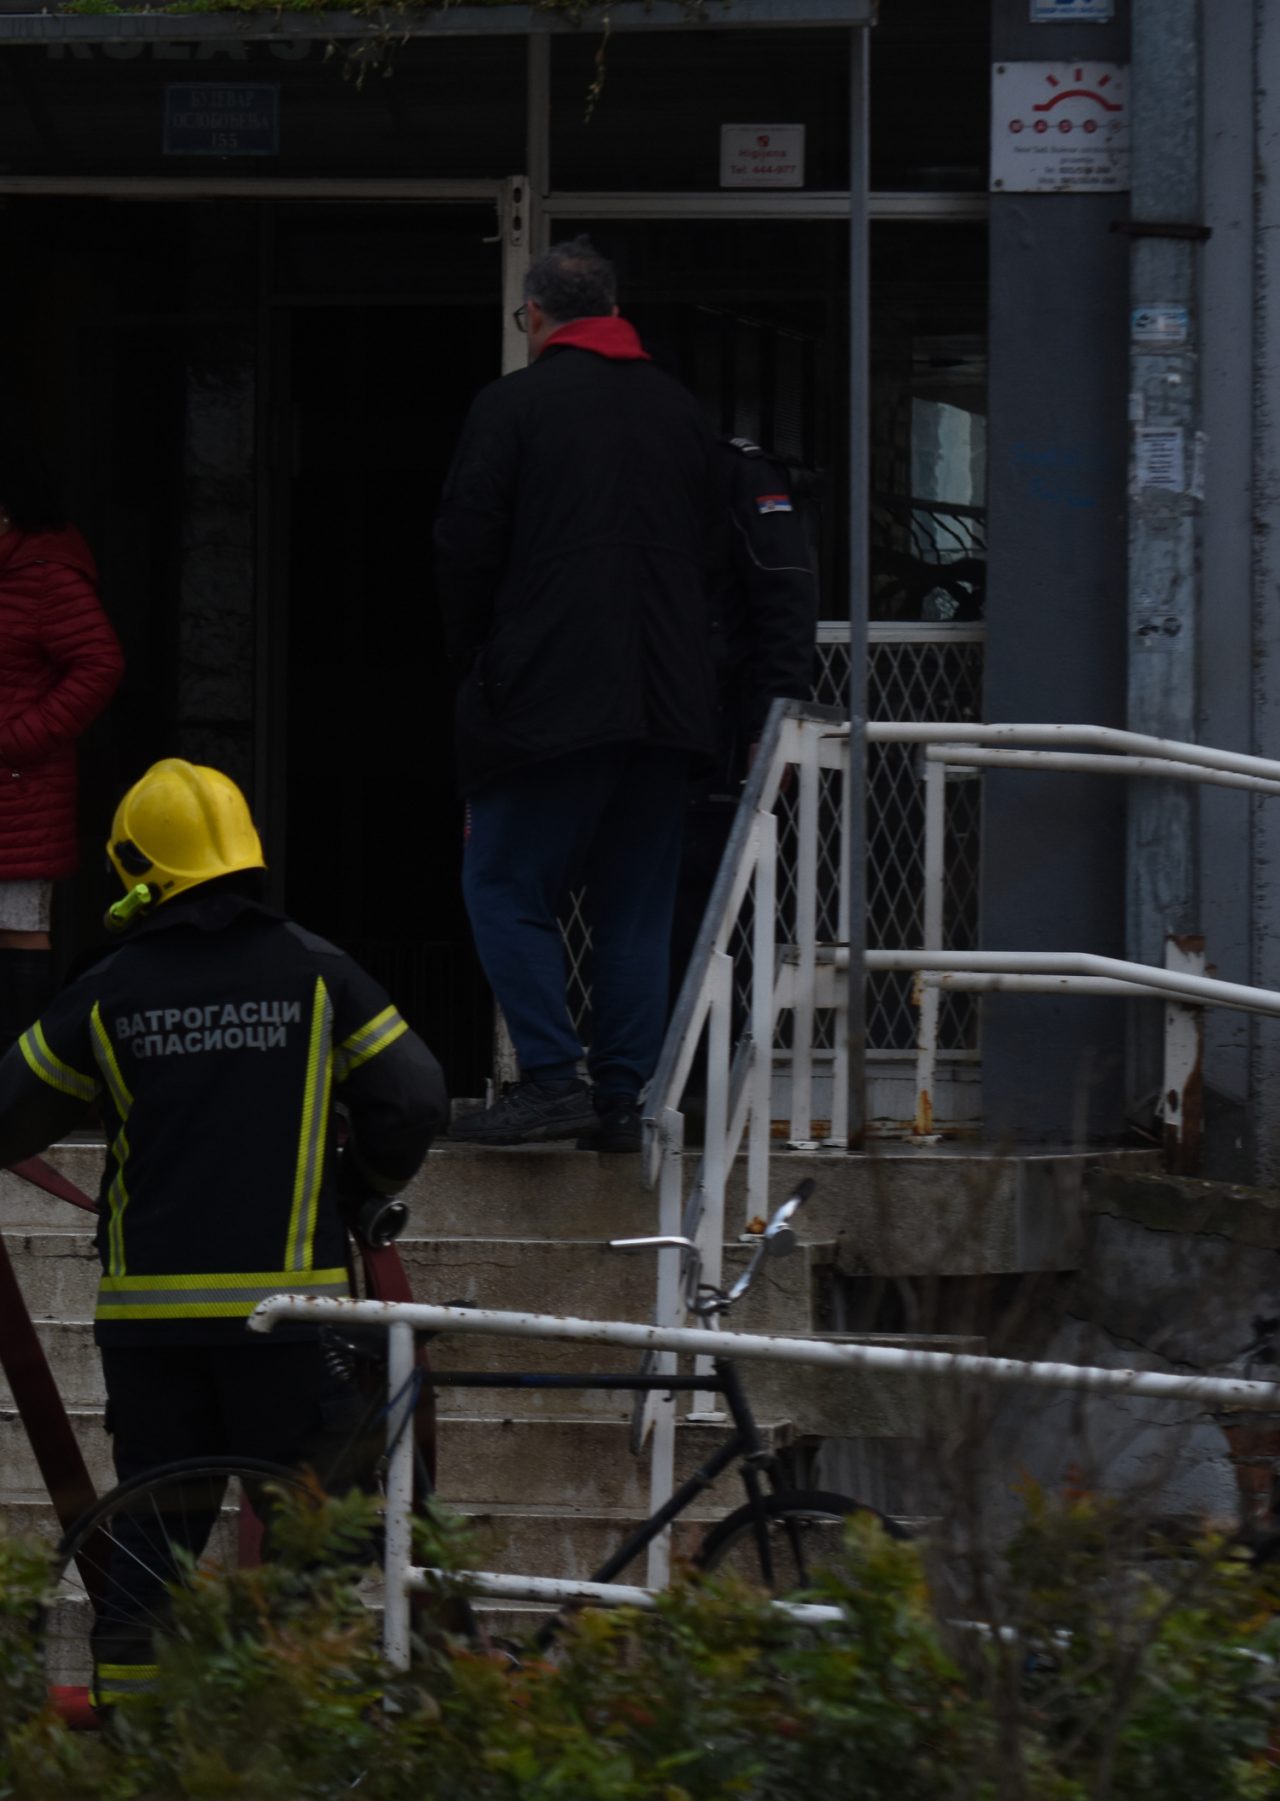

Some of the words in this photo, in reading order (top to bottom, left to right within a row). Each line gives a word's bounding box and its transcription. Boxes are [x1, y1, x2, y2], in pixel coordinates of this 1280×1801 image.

[210, 132, 239, 148] 155
[114, 1000, 302, 1041] ВАТРОГАСЦИ
[131, 1025, 288, 1059] СПАСИОЦИ
